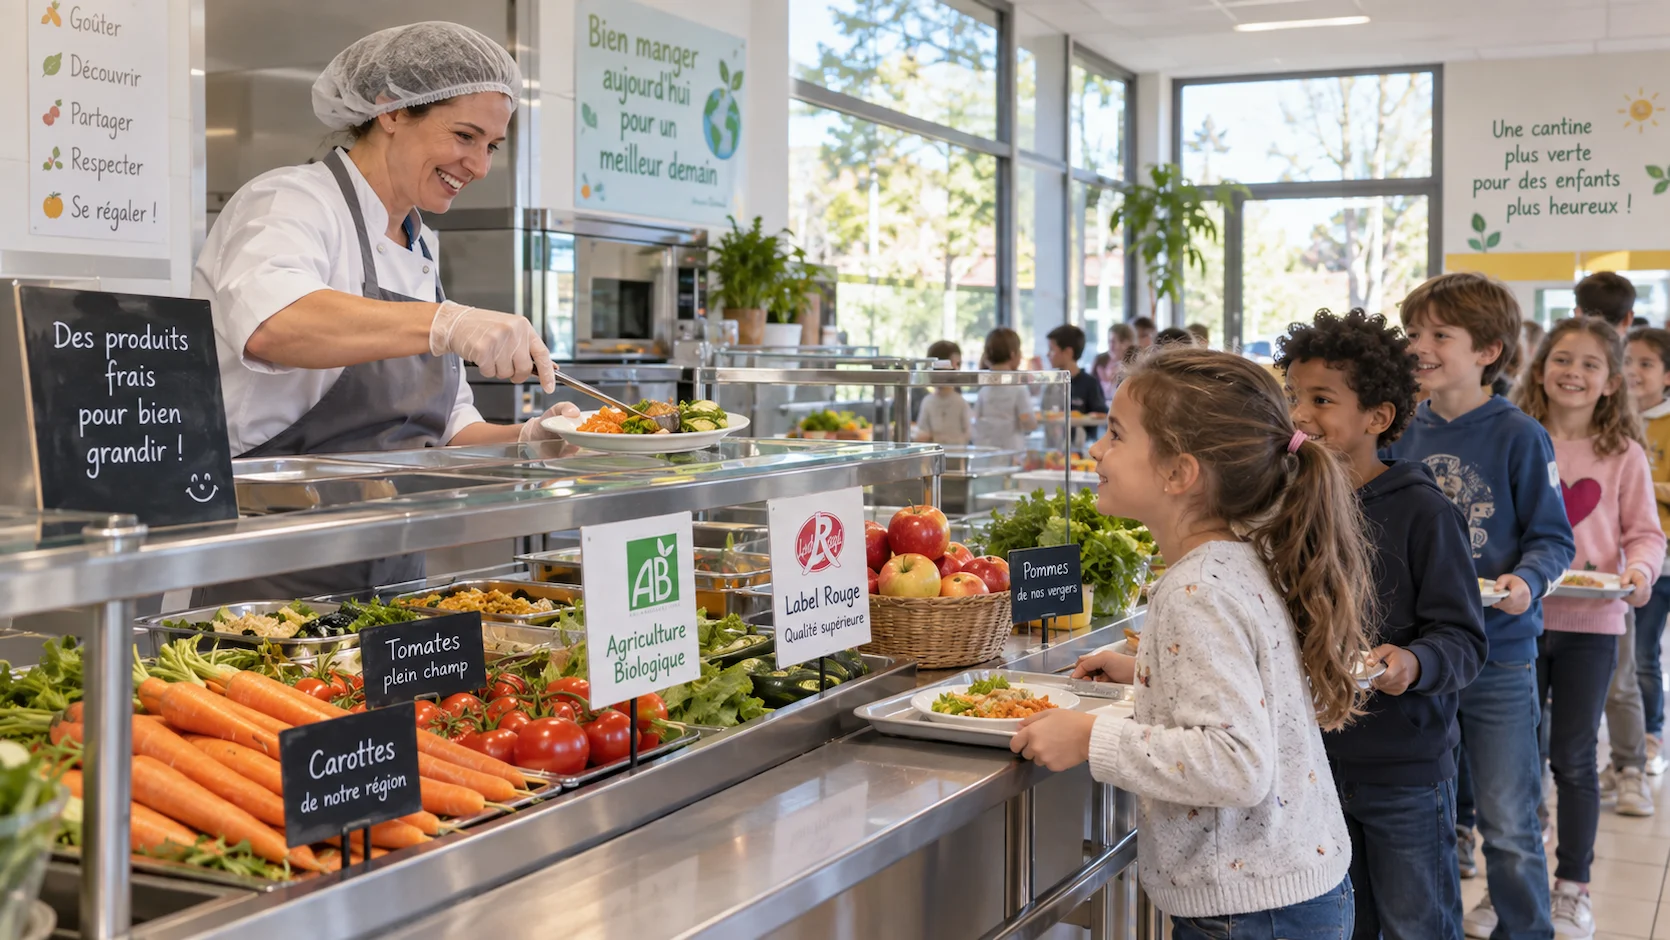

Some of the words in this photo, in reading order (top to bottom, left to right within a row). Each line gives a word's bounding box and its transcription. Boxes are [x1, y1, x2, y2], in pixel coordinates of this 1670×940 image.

[70, 6, 122, 37] Goûter
[588, 13, 628, 54] Bien
[636, 36, 699, 78] manger
[71, 54, 142, 87] Découvrir
[603, 66, 690, 106] aujourd'hui
[71, 101, 133, 140] Partager
[620, 111, 655, 142] pour
[660, 119, 677, 139] un
[1492, 119, 1524, 139] Une
[1531, 117, 1593, 136] cantine
[71, 147, 143, 181] Respecter
[599, 143, 663, 177] meilleur
[668, 151, 718, 186] demain
[1505, 144, 1539, 171] plus
[1547, 143, 1592, 162] verte
[1473, 177, 1510, 199] pour
[1518, 170, 1547, 190] des
[1555, 168, 1620, 192] enfants
[71, 195, 90, 219] Se
[97, 199, 147, 232] régaler
[1507, 196, 1540, 224] plus
[1549, 195, 1618, 215] heureux
[53, 320, 94, 349] Des
[105, 323, 189, 360] produits
[105, 359, 156, 396] frais
[79, 407, 128, 438] pour
[138, 397, 182, 425] bien
[86, 435, 167, 479] grandir
[631, 555, 673, 608] AB
[1023, 561, 1069, 580] Pommes
[785, 587, 820, 616] Label
[824, 583, 861, 609] Rouge
[1017, 587, 1028, 601] de
[1031, 588, 1045, 599] nos
[1047, 584, 1078, 601] vergers
[606, 622, 687, 661] Agriculture
[784, 621, 818, 644] Qualité
[821, 613, 865, 638] supérieure
[384, 633, 461, 661] Tomates
[383, 666, 418, 695] plein
[423, 661, 469, 680] champ
[614, 650, 686, 684] Biologique
[309, 738, 396, 780] Carottes
[300, 792, 319, 814] de
[323, 784, 360, 808] notre
[365, 774, 407, 802] région
